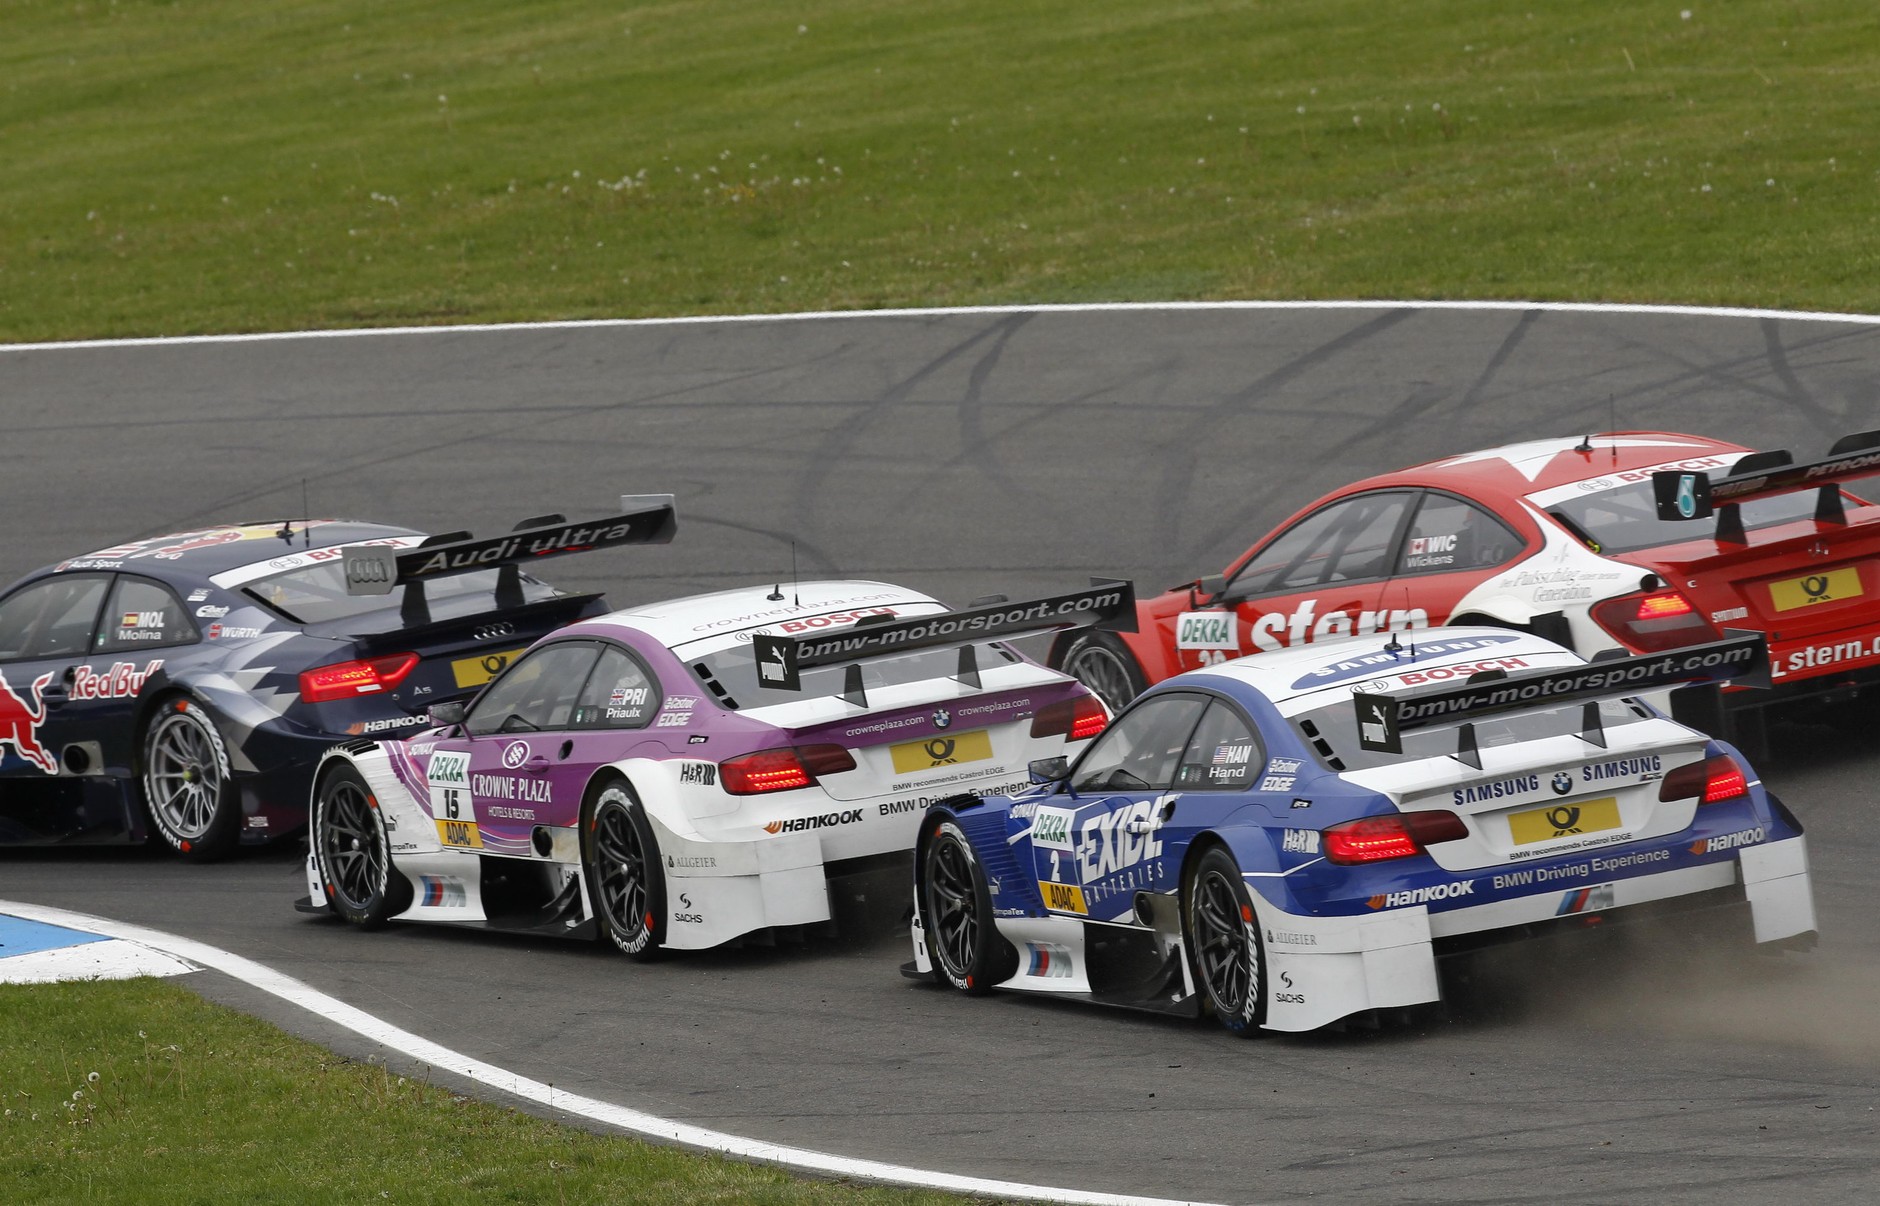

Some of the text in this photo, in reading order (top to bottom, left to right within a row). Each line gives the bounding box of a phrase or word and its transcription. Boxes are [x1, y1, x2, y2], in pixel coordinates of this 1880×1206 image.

[1618, 458, 1725, 482] BOCH
[415, 524, 630, 574] Audi ultra
[1428, 535, 1457, 553] WIC
[93, 559, 123, 570] Sport
[137, 612, 165, 628] MOL
[692, 592, 900, 632] crowneplaza.com
[780, 607, 900, 634] BOSCH
[118, 630, 161, 640] Molina
[796, 592, 1121, 660] bmw-motorsport.com
[1181, 619, 1229, 643] DEKRA
[1316, 639, 1497, 676] SAMSUNG
[1397, 645, 1753, 721] bmw-motorsport.com
[1399, 658, 1529, 685] BOSCH
[622, 688, 648, 705] PRI
[958, 698, 1031, 717] crowneplaza.com
[606, 707, 641, 718] Priaulx
[656, 712, 693, 727] EDGE
[846, 714, 925, 736] crowneplaza.com
[1225, 745, 1252, 763] HAN
[429, 756, 465, 783] DEKRA
[892, 767, 1005, 791] BMW recommends Castrol EDGE
[1209, 766, 1246, 778] Hand
[1583, 755, 1662, 782] SAMSUNG
[473, 774, 552, 803] CROWNE PLAZA
[1260, 777, 1297, 791] EDGE
[1454, 774, 1540, 806] SAMSUNG
[444, 790, 459, 819] 15
[488, 806, 535, 820] HOTELS & RESORTS
[879, 799, 916, 815] BMW
[446, 822, 471, 845] ADAC
[1033, 814, 1069, 843] DEKRA
[1076, 793, 1183, 885] EXIDE
[1509, 833, 1632, 860] BMW recommends Castrol EDGE
[677, 857, 717, 868] ALLGEIER
[1050, 850, 1061, 882] 2
[1493, 849, 1670, 889] BMW Driving Experience
[1084, 861, 1163, 906] BATTERIES
[1050, 884, 1075, 911] ADAC
[675, 913, 703, 923] SACHS
[1276, 932, 1318, 946] ALLGEIER
[1276, 993, 1305, 1004] SACHS
